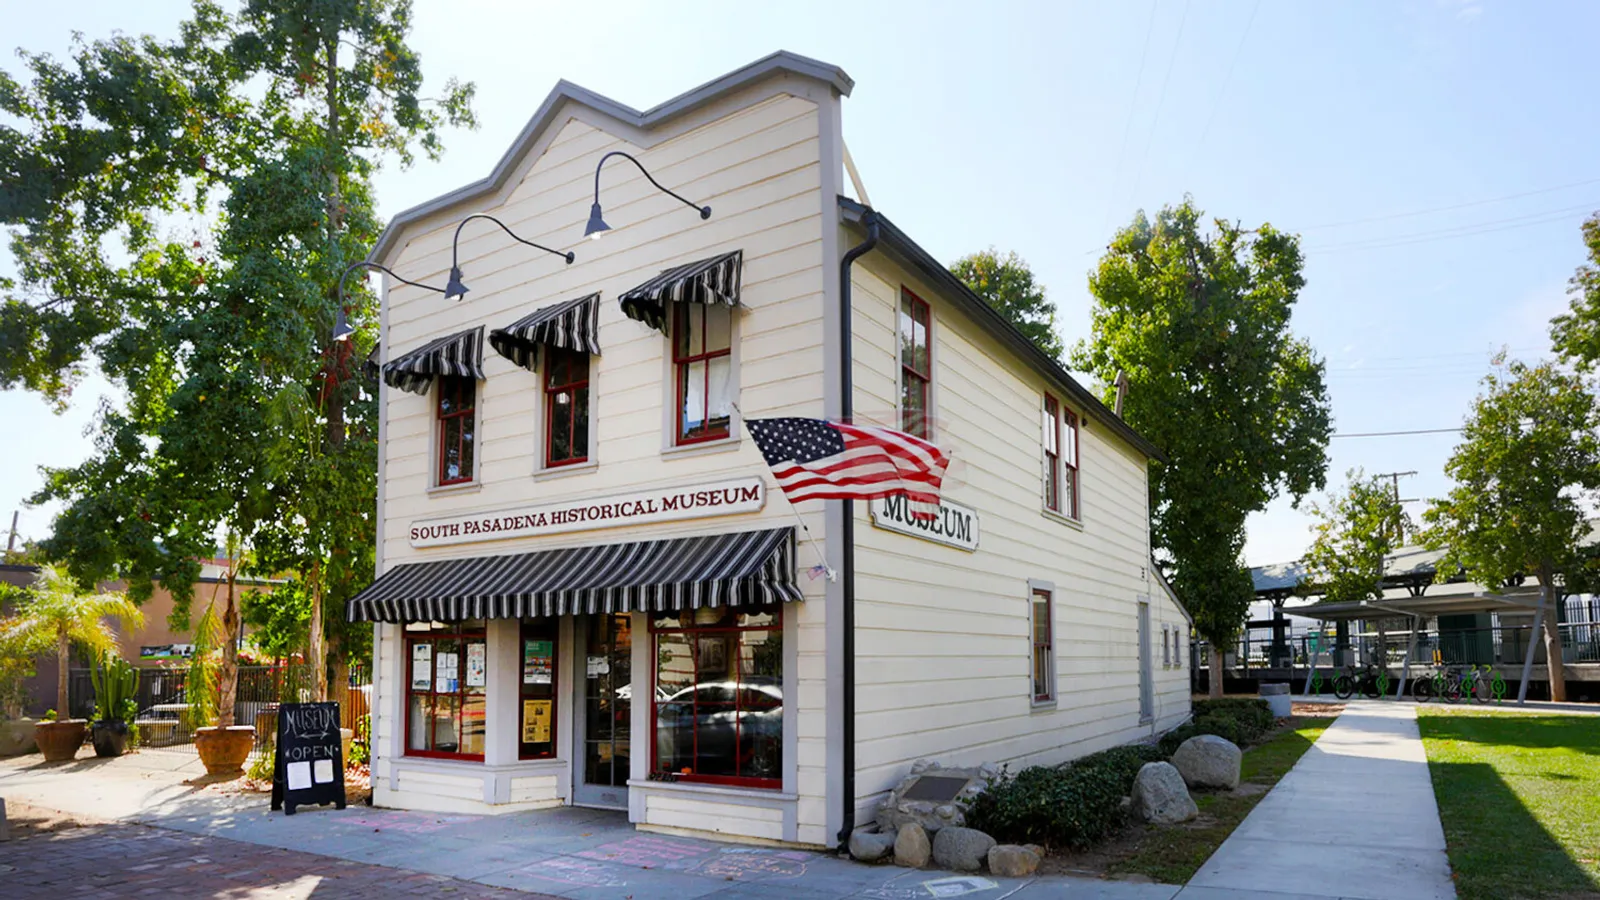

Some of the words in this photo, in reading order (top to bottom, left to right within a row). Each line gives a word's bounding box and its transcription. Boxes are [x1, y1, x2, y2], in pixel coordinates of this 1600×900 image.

[410, 523, 460, 540] SOUTH
[463, 512, 548, 535] PASADENA
[550, 499, 658, 525] HISTORICAL
[661, 484, 760, 512] MUSEUM
[284, 708, 340, 738] MUSEUM
[291, 745, 334, 760] OPEN
